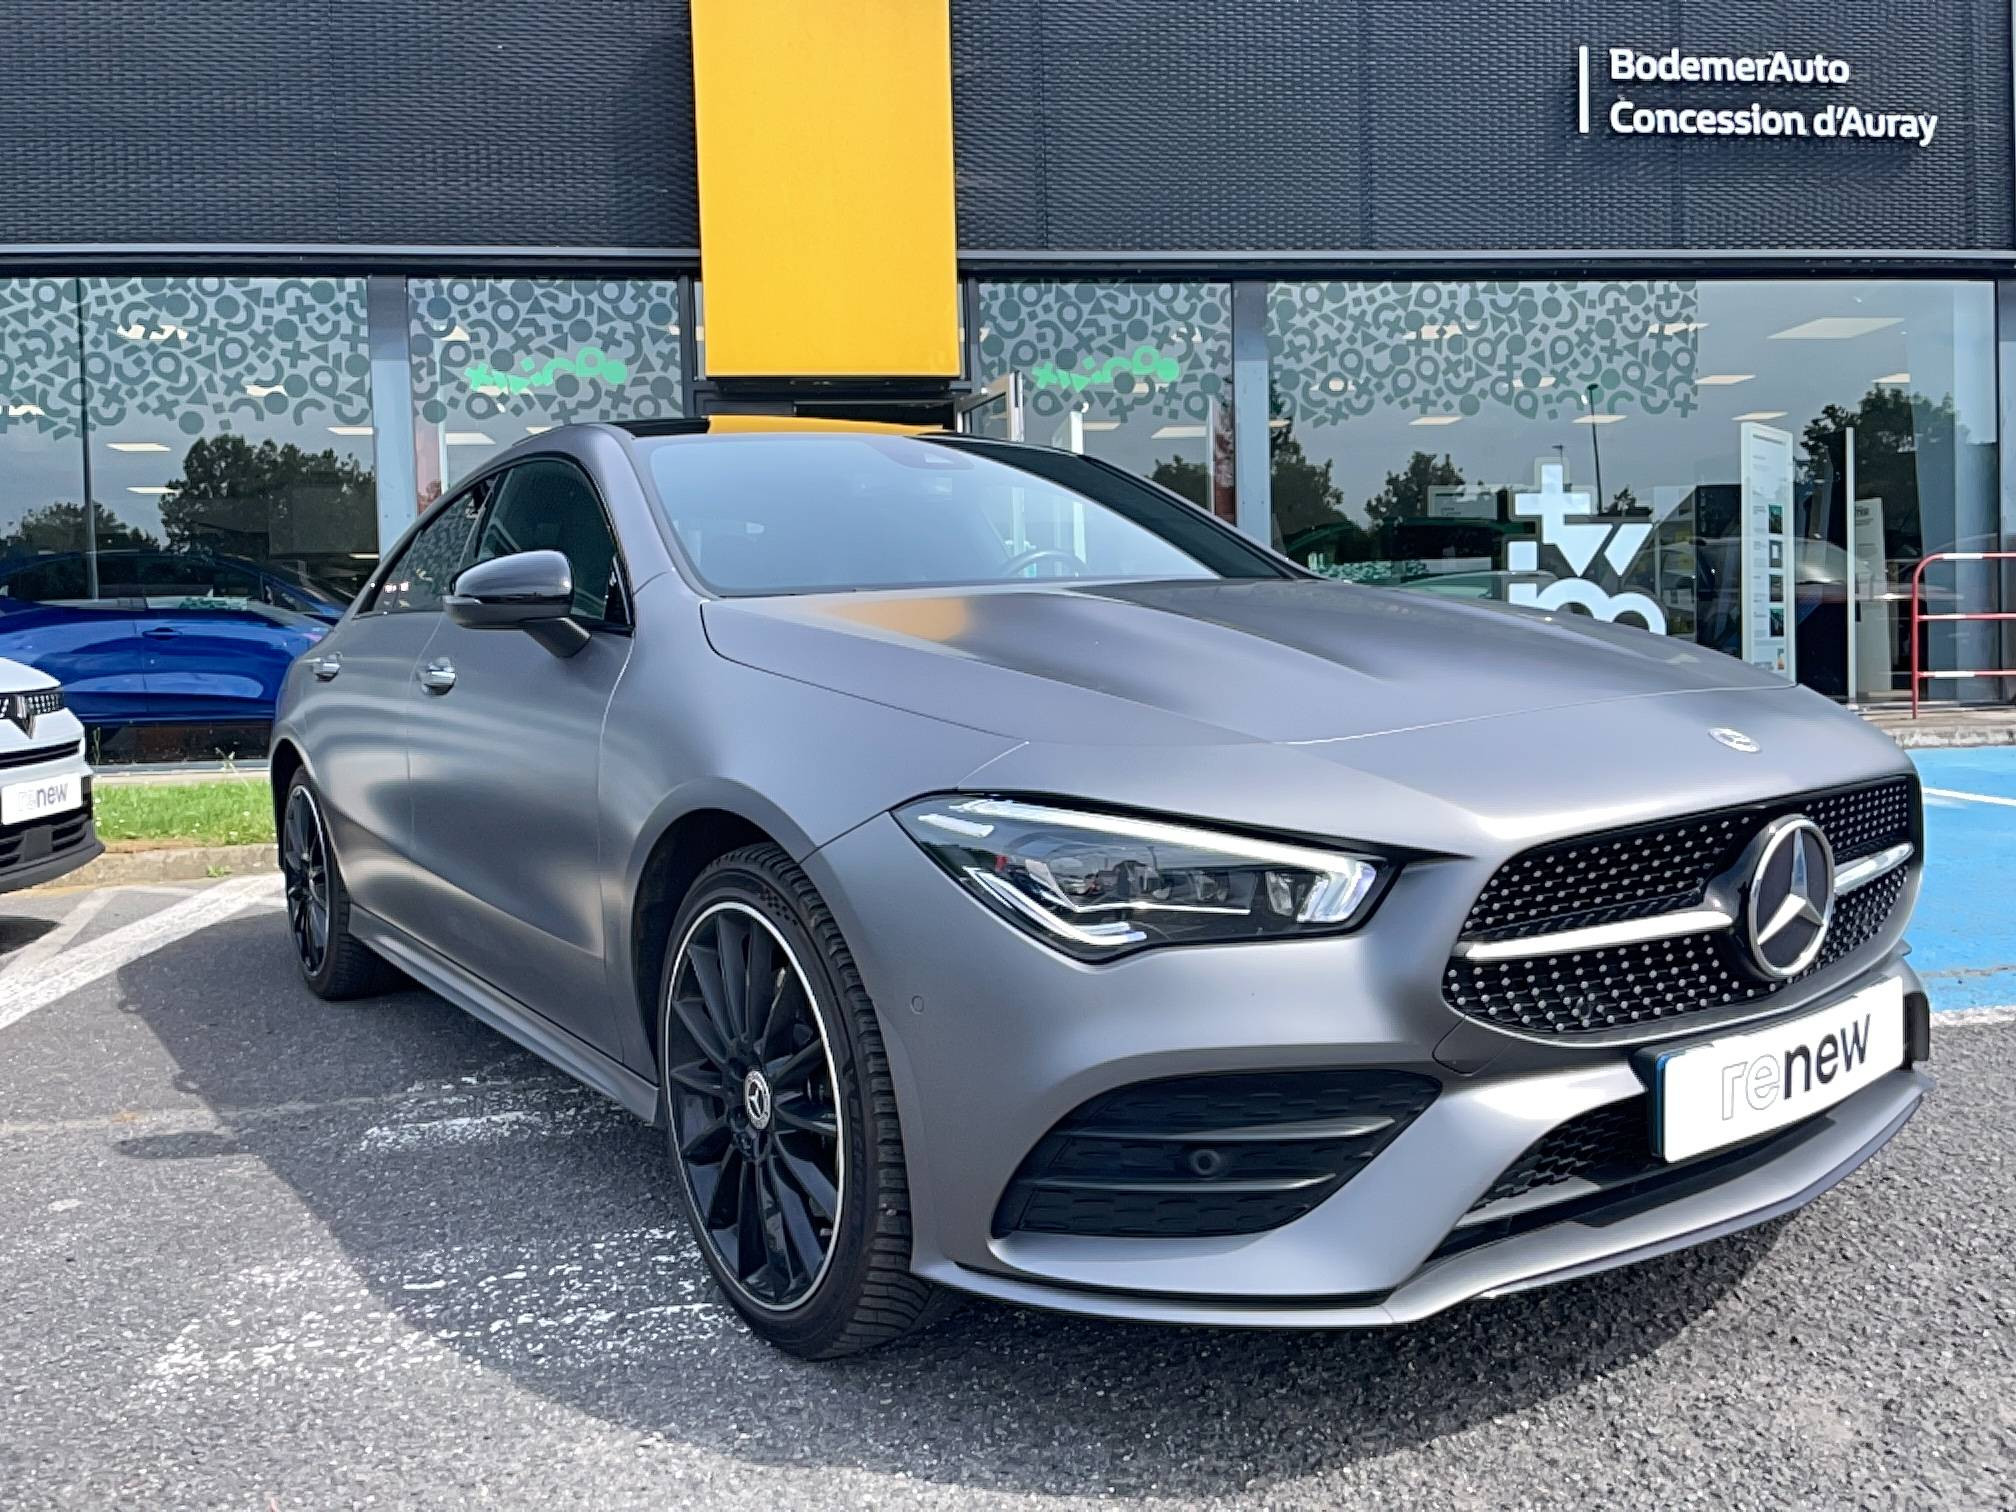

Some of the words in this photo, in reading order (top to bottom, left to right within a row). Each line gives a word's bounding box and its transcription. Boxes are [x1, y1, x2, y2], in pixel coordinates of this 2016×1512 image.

[1610, 47, 1849, 84] BodemerAuto
[1610, 100, 1808, 136] Concession
[1813, 105, 1938, 147] d'Auray
[18, 781, 69, 812] renew
[1721, 1013, 1871, 1121] renew
